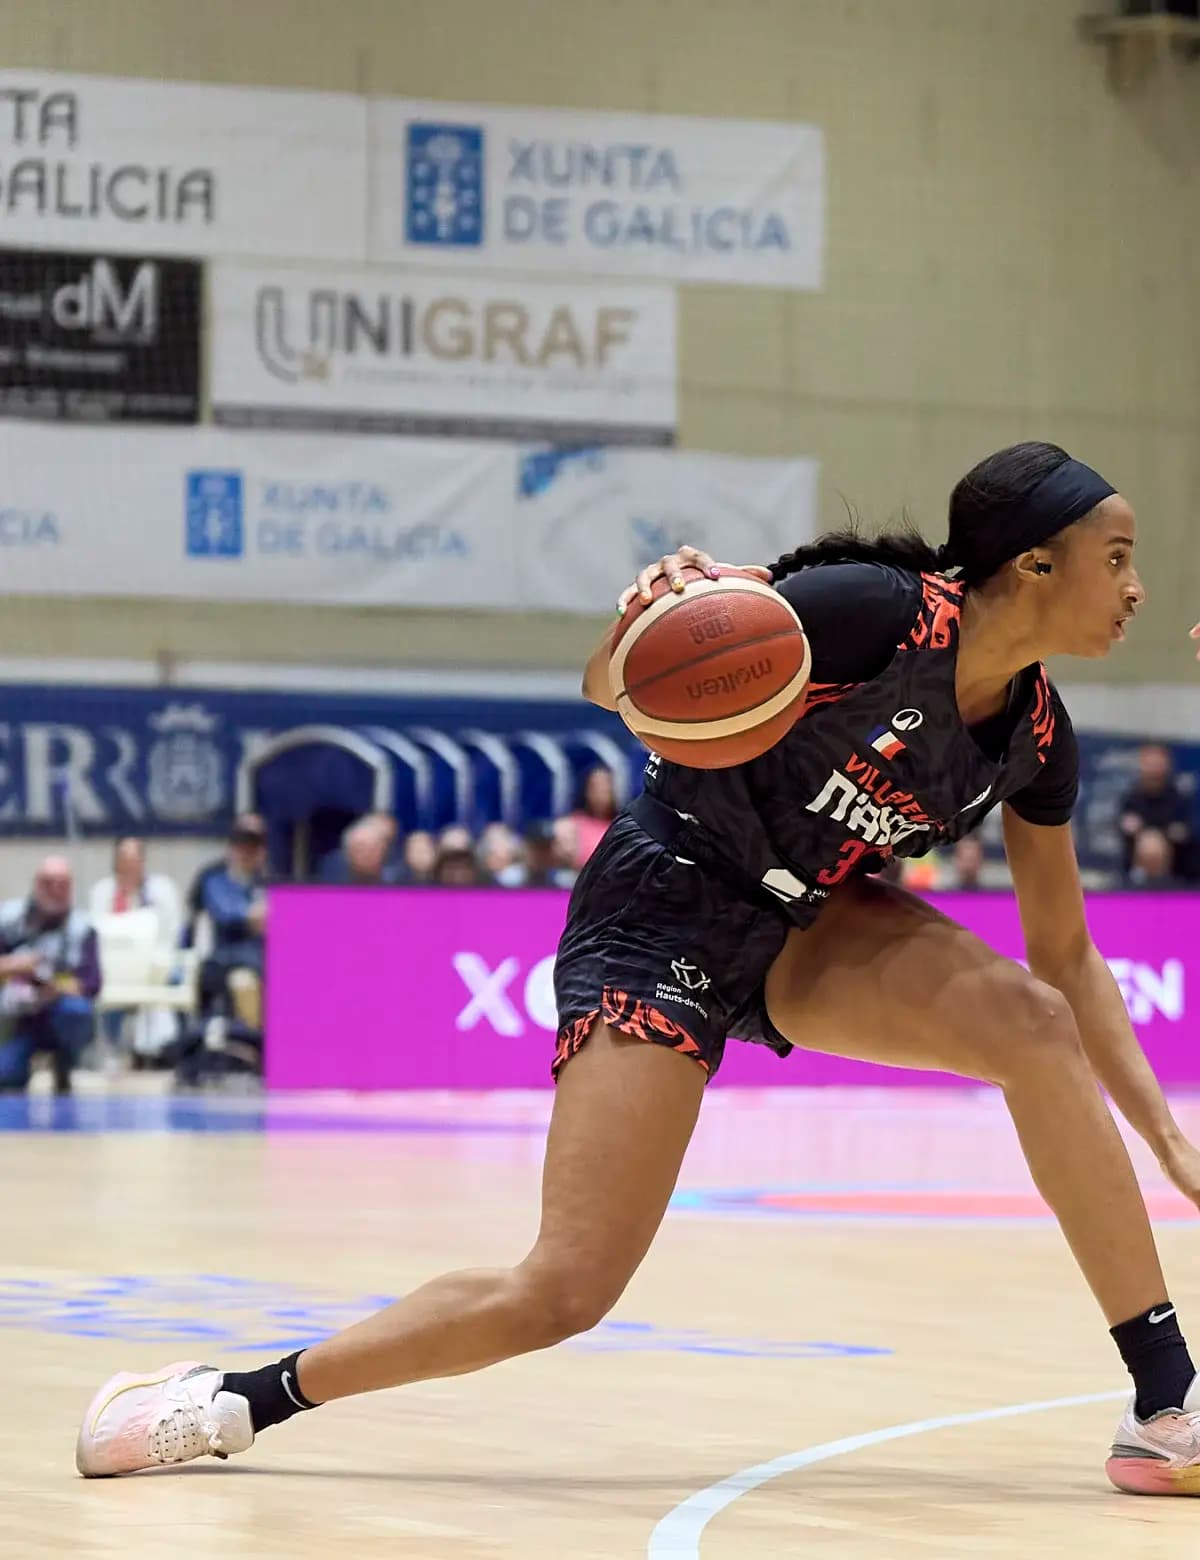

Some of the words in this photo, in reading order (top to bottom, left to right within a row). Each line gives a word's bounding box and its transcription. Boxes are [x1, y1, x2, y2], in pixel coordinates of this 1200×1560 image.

[0, 158, 214, 224] ALICIA
[507, 139, 682, 192] XUNTA
[503, 195, 569, 244] DE
[584, 199, 791, 253] GALICIA
[256, 285, 638, 383] UNIGRAF
[686, 657, 772, 699] molten
[656, 982, 682, 993] Région
